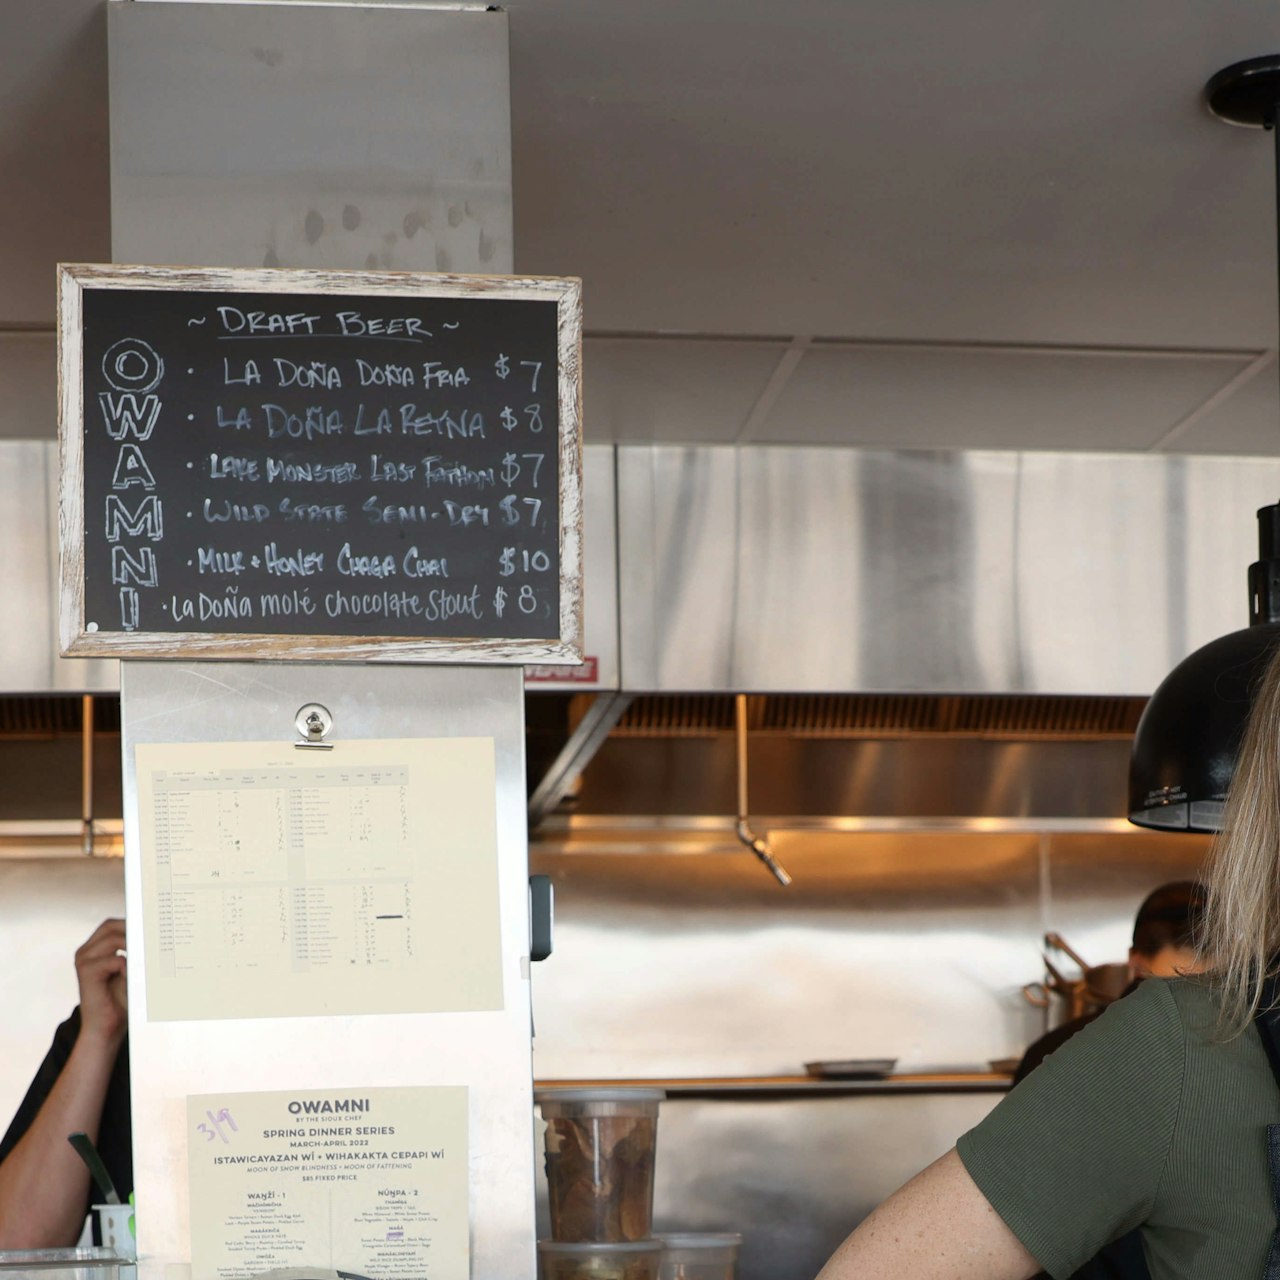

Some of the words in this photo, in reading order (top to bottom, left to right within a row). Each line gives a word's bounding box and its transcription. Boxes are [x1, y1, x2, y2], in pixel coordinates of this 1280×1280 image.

[217, 307, 321, 333] DRAFT
[336, 311, 433, 336] BEER
[224, 358, 261, 385] LA
[274, 358, 341, 389] DOÑA
[356, 358, 414, 387] DOÑA
[423, 362, 470, 389] FRIA
[217, 405, 252, 429] LA
[261, 403, 342, 440] DOÑA
[353, 404, 392, 434] LA
[210, 453, 260, 482] LAKE
[266, 457, 361, 483] MONSTER
[370, 454, 416, 482] LAST
[204, 498, 270, 522] WILD
[279, 497, 347, 523] STATE
[198, 547, 245, 575] MILK
[264, 542, 324, 576] HONEY
[337, 542, 396, 579] CHAGA
[403, 546, 449, 578] CHAI
[325, 589, 423, 618] chocolate
[288, 1099, 370, 1115] OWAMNI
[263, 1129, 306, 1139] SPRING
[309, 1127, 352, 1137] DINNER
[355, 1126, 395, 1136] SERIES
[289, 1140, 348, 1148] MARCH-APRIL
[349, 1139, 369, 1147] 2022
[214, 1154, 299, 1165] ISTAWICAYAZAN
[325, 1152, 388, 1161] WIHAKAKTA
[391, 1151, 428, 1160] CEPAPI
